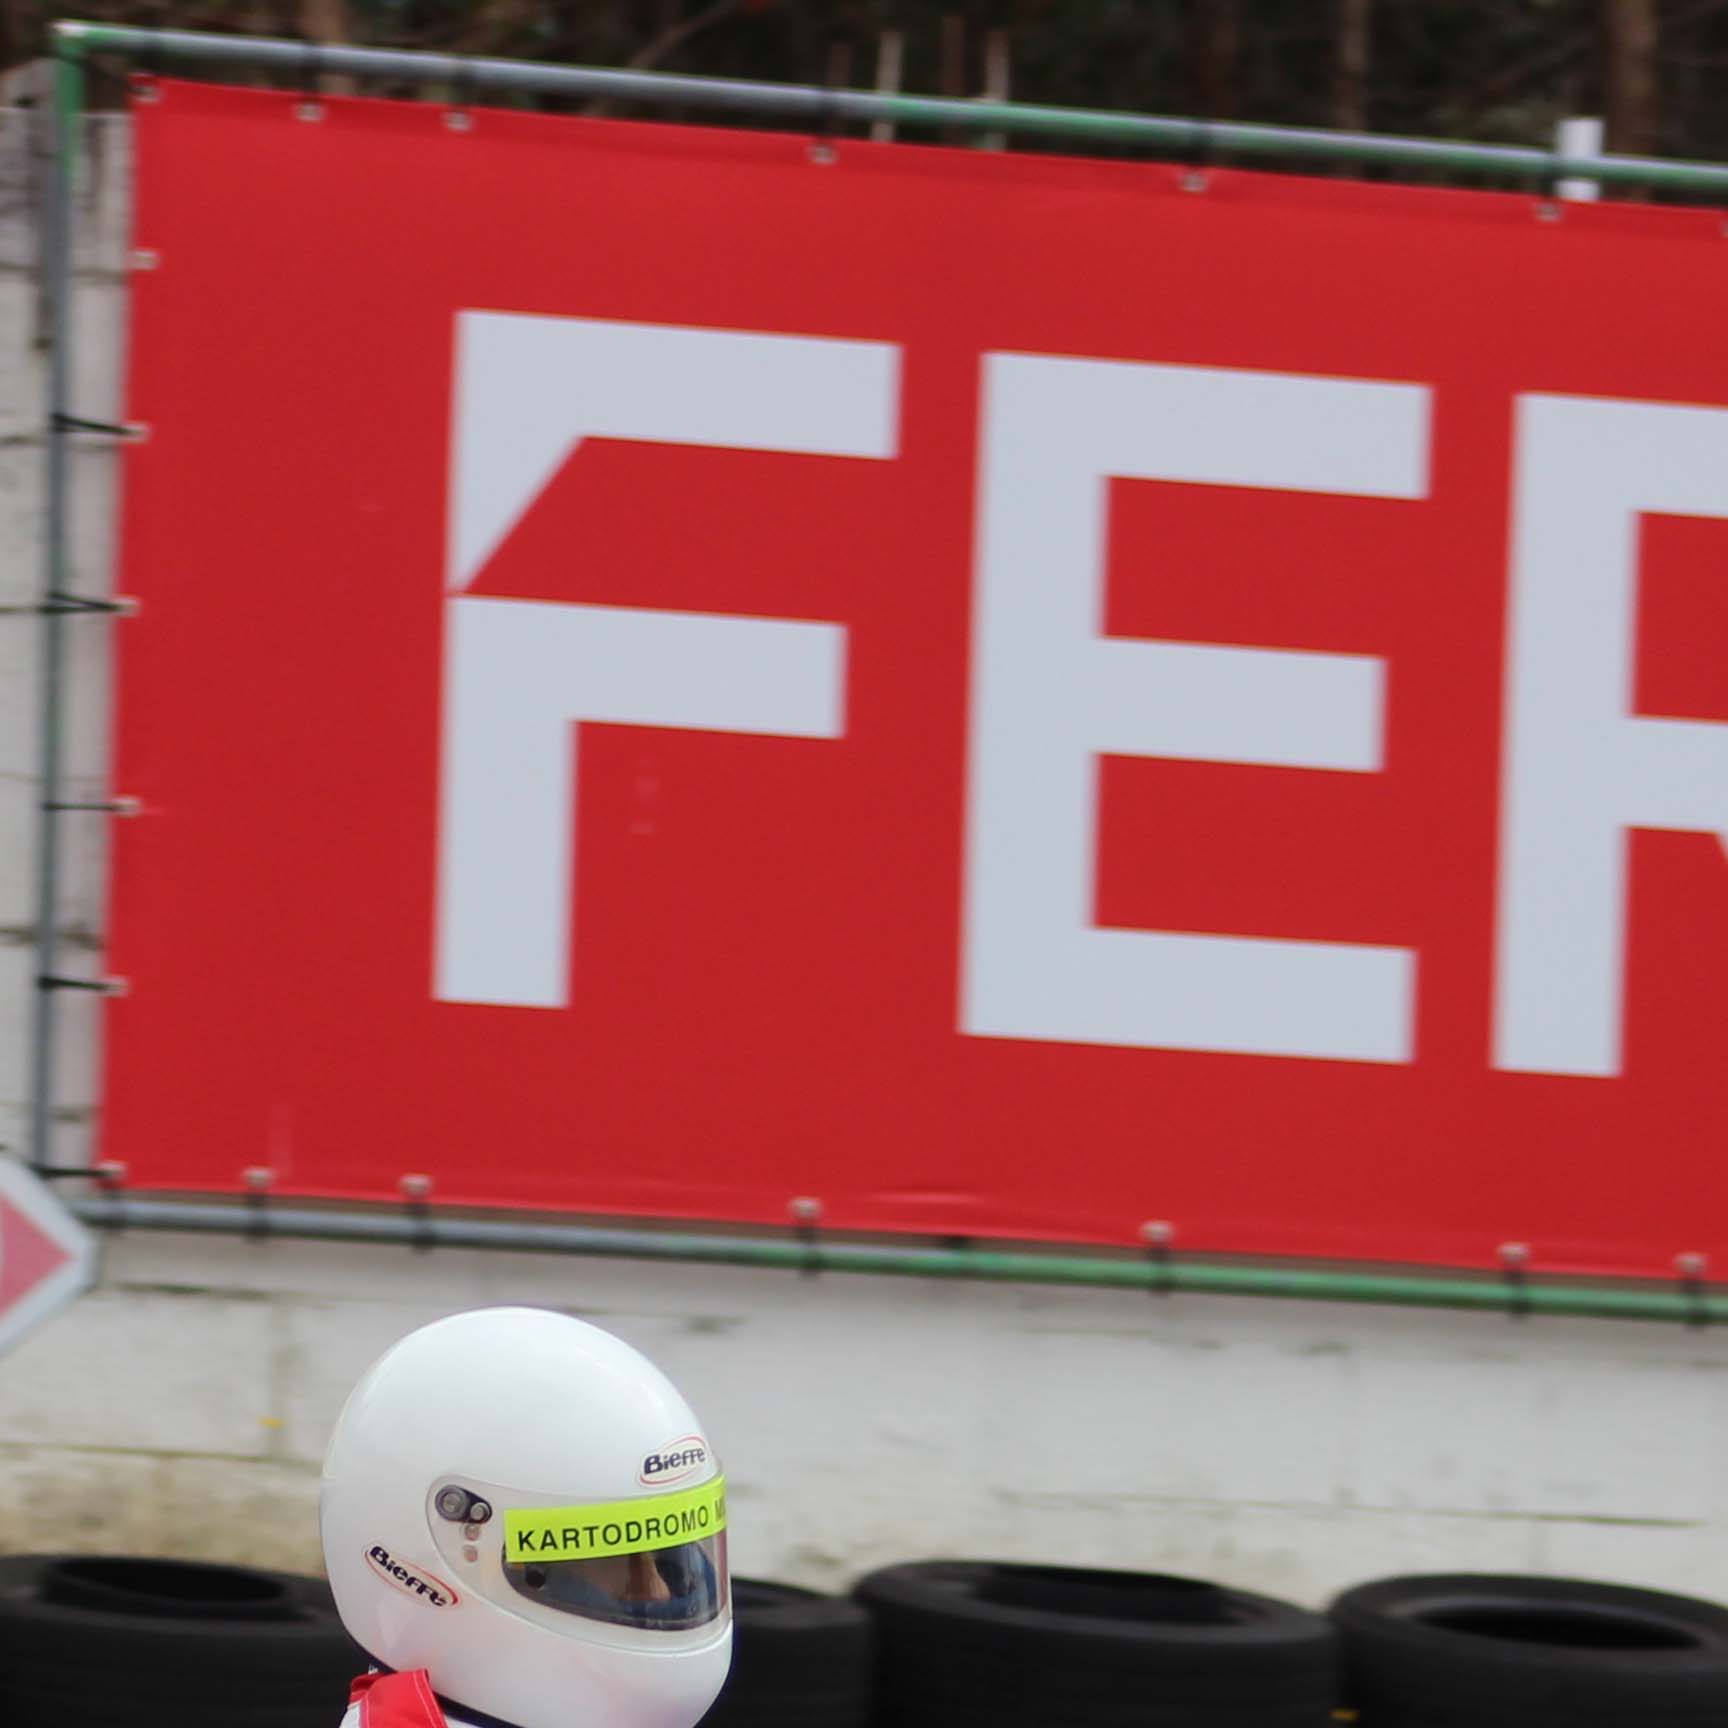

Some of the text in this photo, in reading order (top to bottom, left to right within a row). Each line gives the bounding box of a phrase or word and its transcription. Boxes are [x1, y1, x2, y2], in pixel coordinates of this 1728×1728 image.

[644, 1448, 705, 1475] Bieffe
[517, 1505, 709, 1552] KARTODROMO
[370, 1546, 448, 1607] Bieffe
